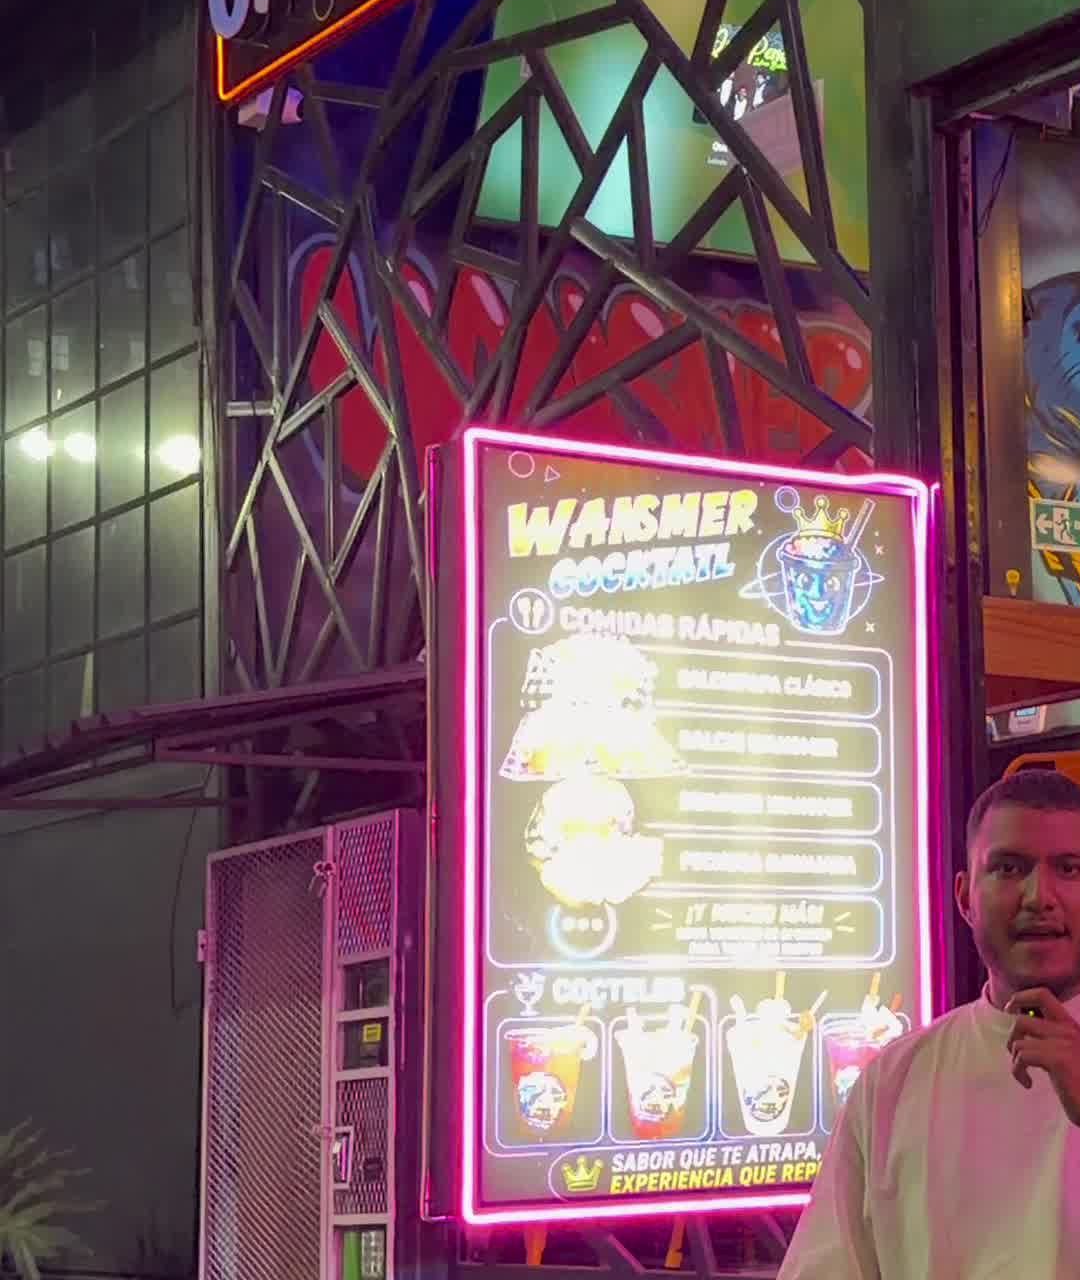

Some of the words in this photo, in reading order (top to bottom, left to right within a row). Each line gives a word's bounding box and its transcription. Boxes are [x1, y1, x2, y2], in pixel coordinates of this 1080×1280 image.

[507, 489, 758, 558] WANSMER
[548, 542, 736, 600] COCKTAIL
[559, 605, 674, 640] COMIDAS
[610, 1151, 676, 1173] SABOR
[680, 1147, 719, 1168] QUE
[720, 1146, 743, 1165] TE
[745, 1141, 823, 1163] ATRAPA,
[609, 1167, 734, 1195] EXPERIENCIA
[739, 1163, 778, 1186] QUE
